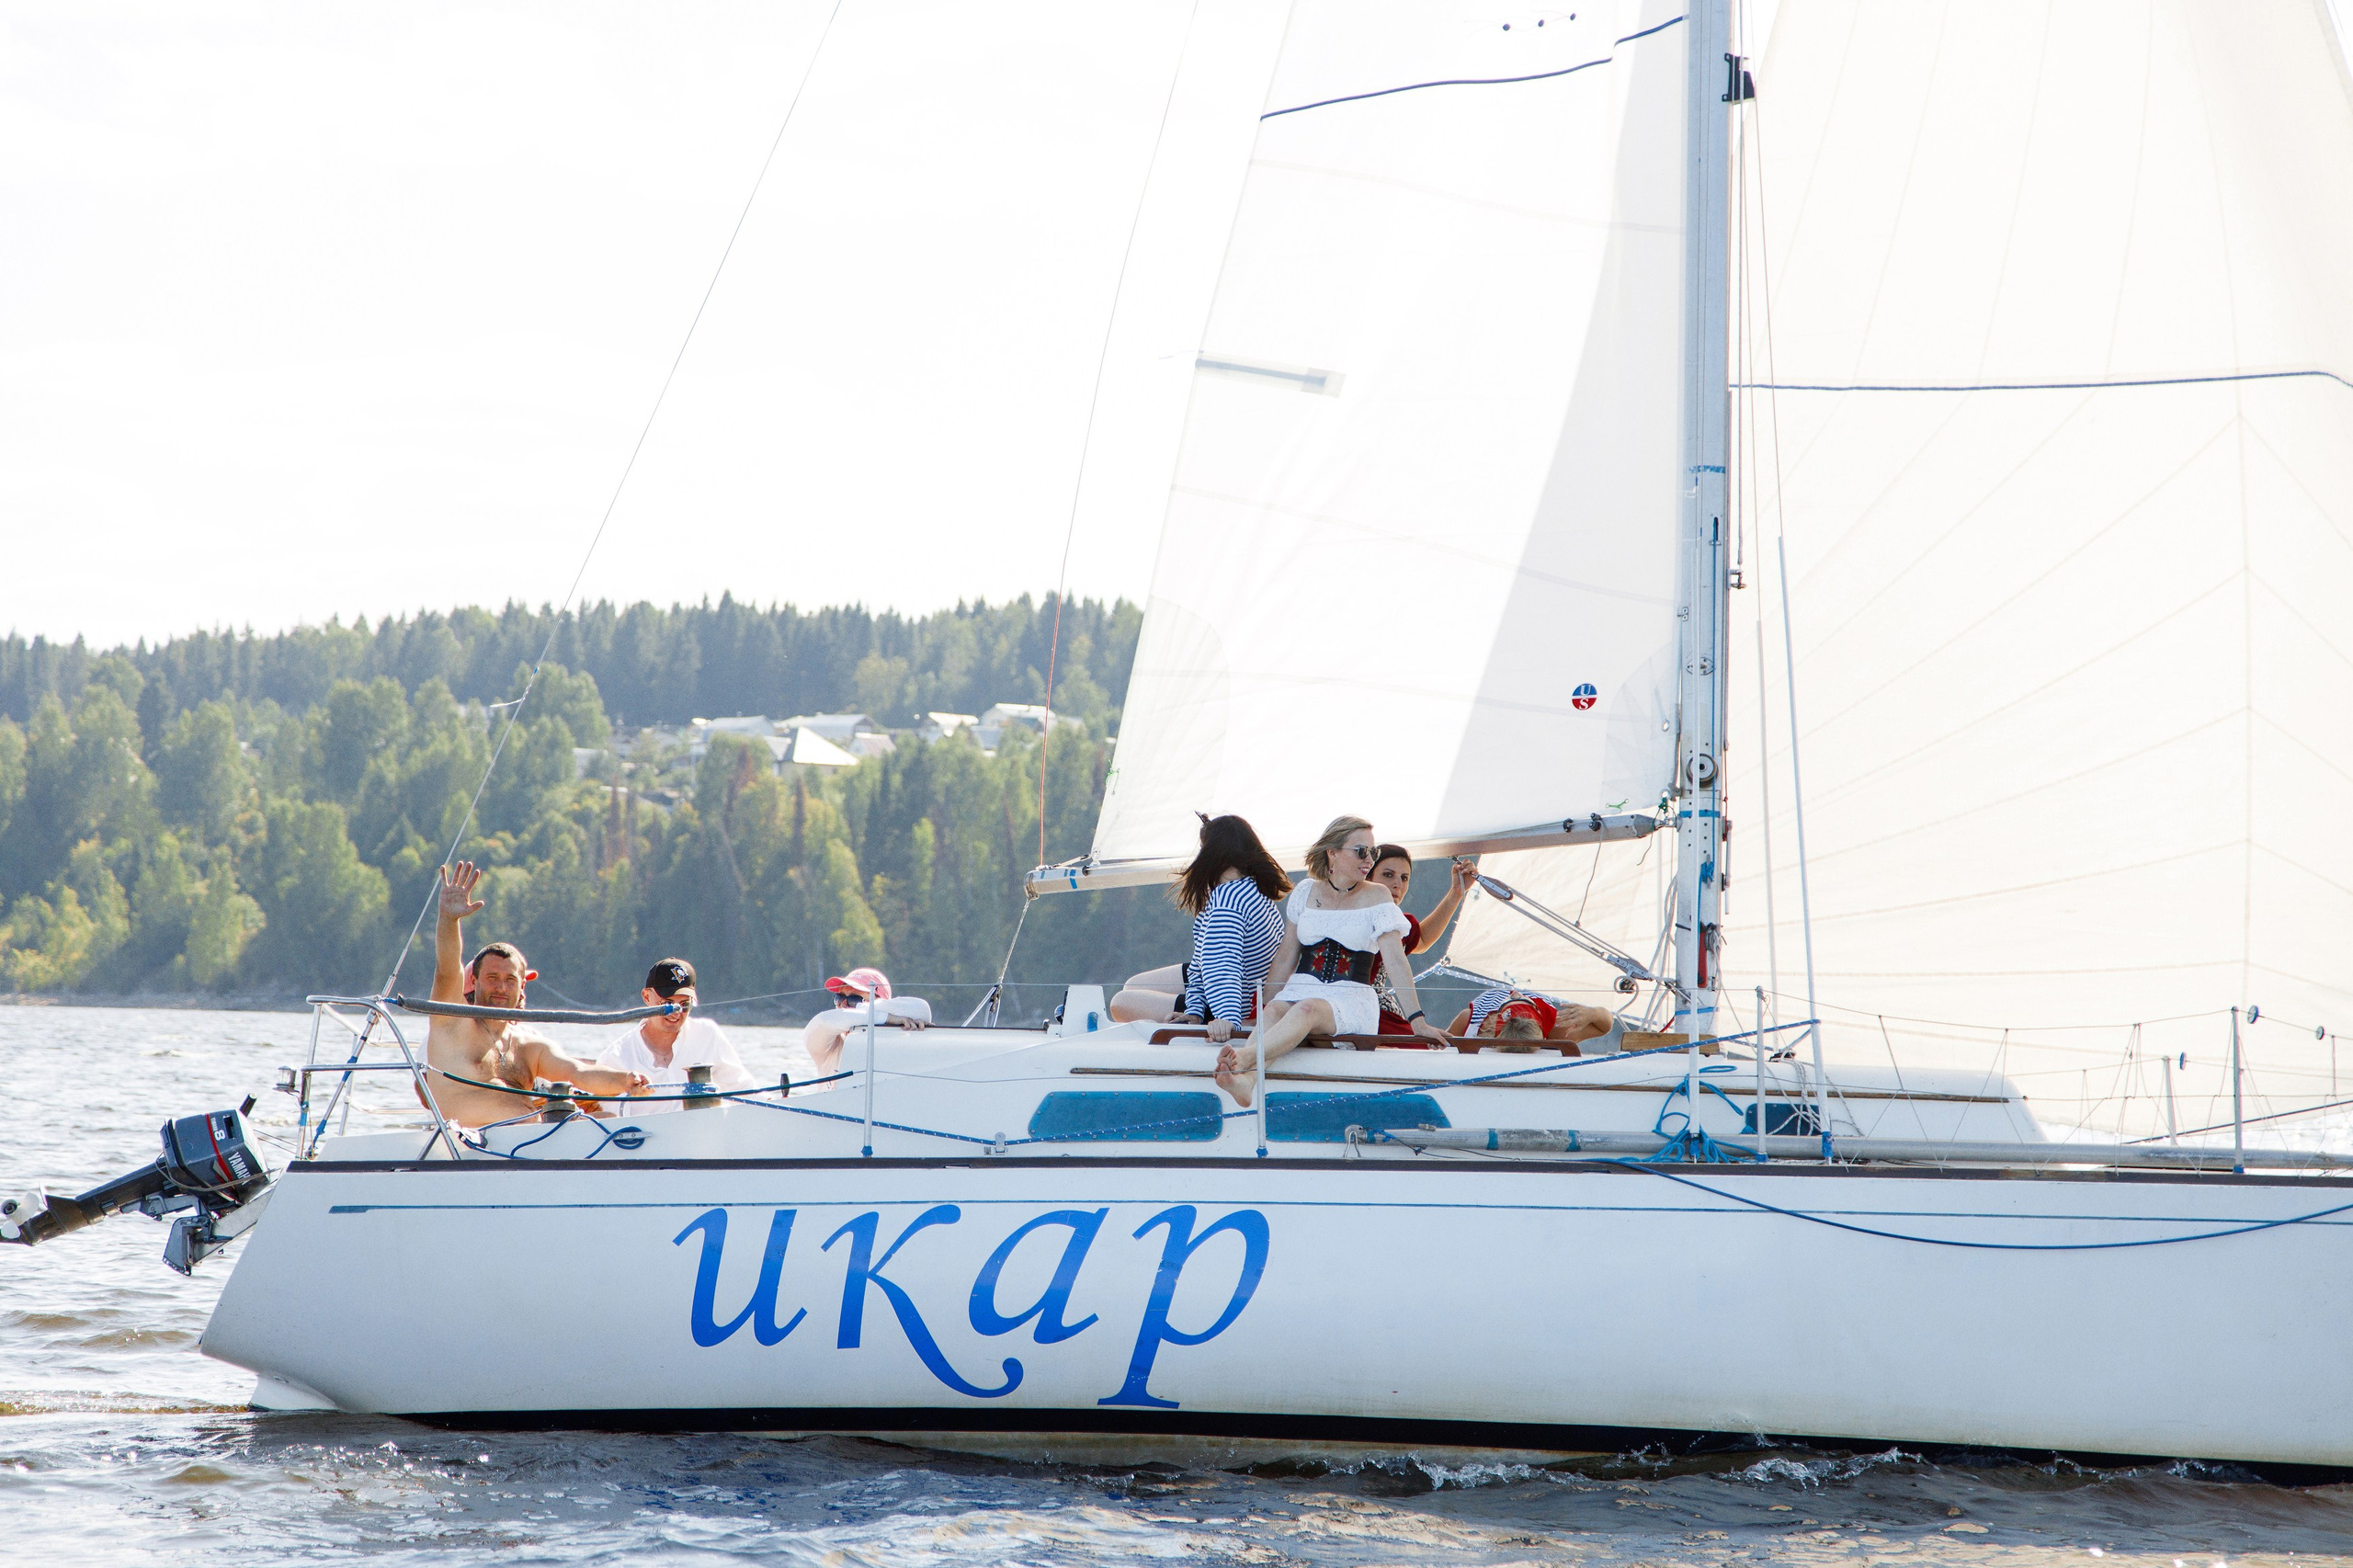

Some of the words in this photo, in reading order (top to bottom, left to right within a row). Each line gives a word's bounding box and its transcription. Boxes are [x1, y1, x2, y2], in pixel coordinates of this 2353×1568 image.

[1581, 685, 1592, 696] U
[1579, 699, 1588, 710] S
[214, 1130, 226, 1142] 8
[672, 1203, 1270, 1409] икар
